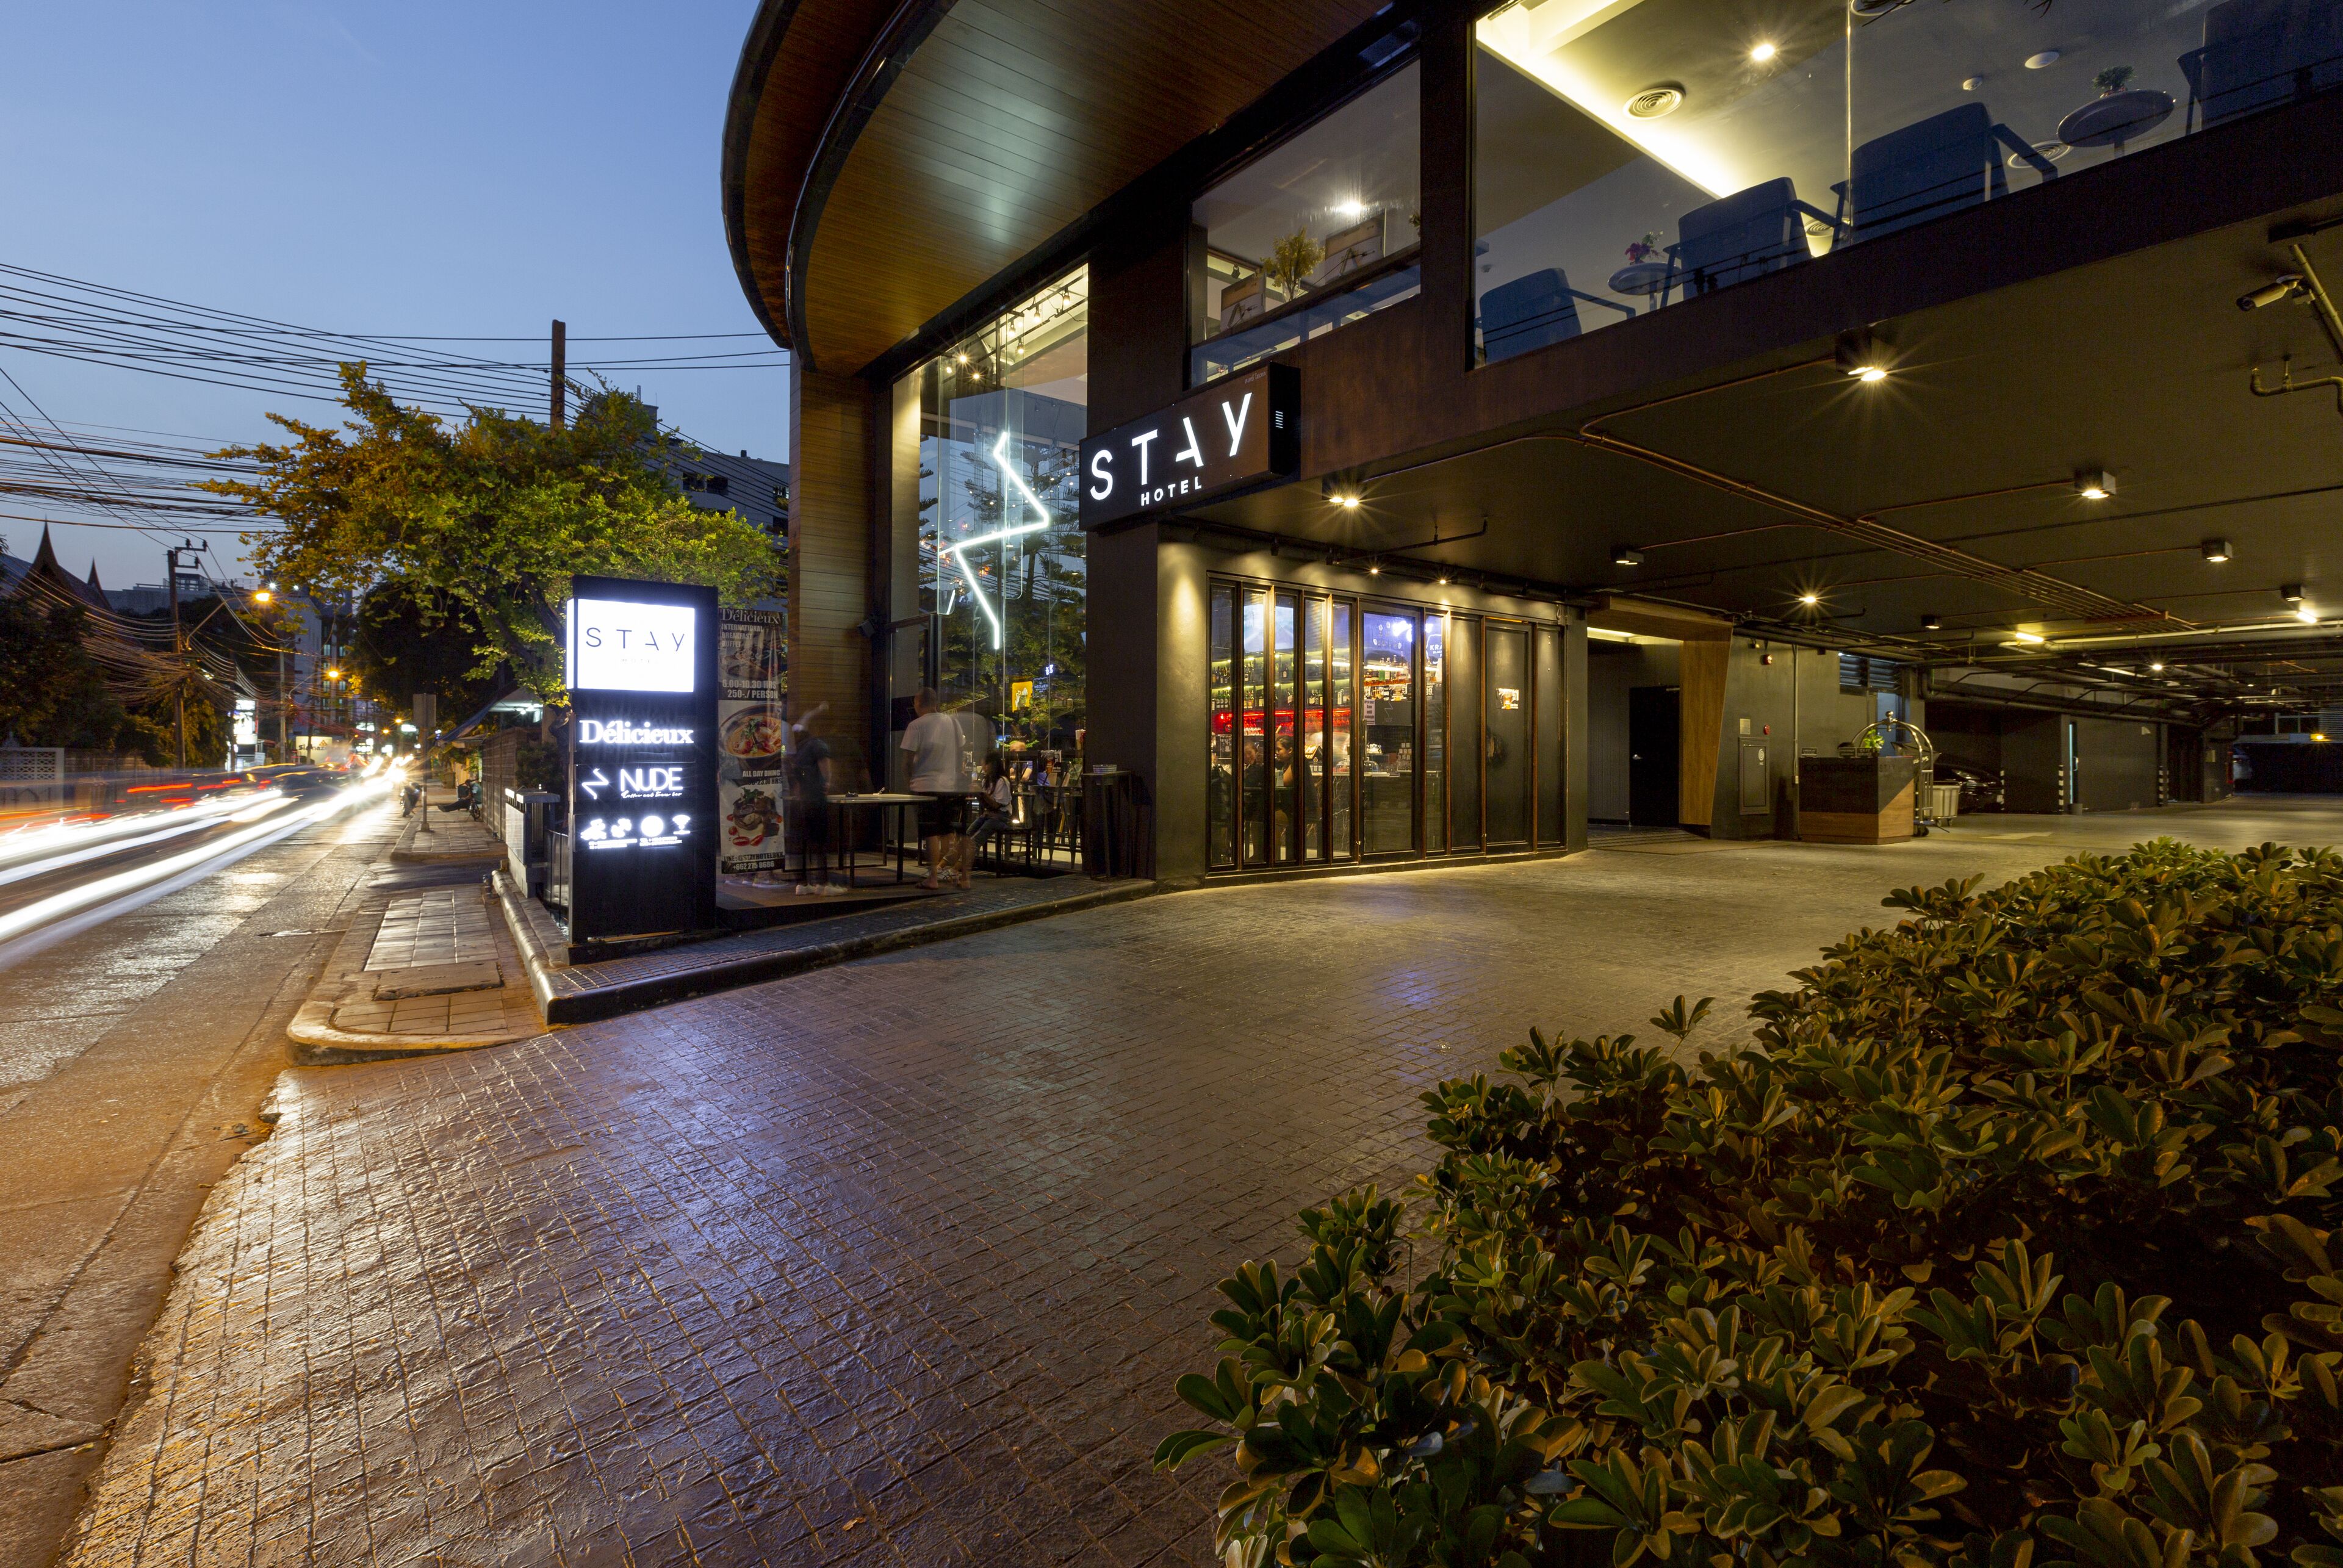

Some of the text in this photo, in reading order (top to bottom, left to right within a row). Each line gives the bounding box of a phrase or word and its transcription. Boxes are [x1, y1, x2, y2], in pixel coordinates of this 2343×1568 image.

[1090, 392, 1252, 500] STAY
[1141, 477, 1202, 506] HOTEL
[721, 608, 779, 624] Délicieux
[586, 627, 685, 652] STAY
[721, 624, 763, 632] INTERNATIONAL
[722, 679, 762, 689] 6.00-10.30
[752, 690, 779, 699] PERSON
[579, 720, 694, 744] Délicieux
[621, 768, 683, 791] NUDE
